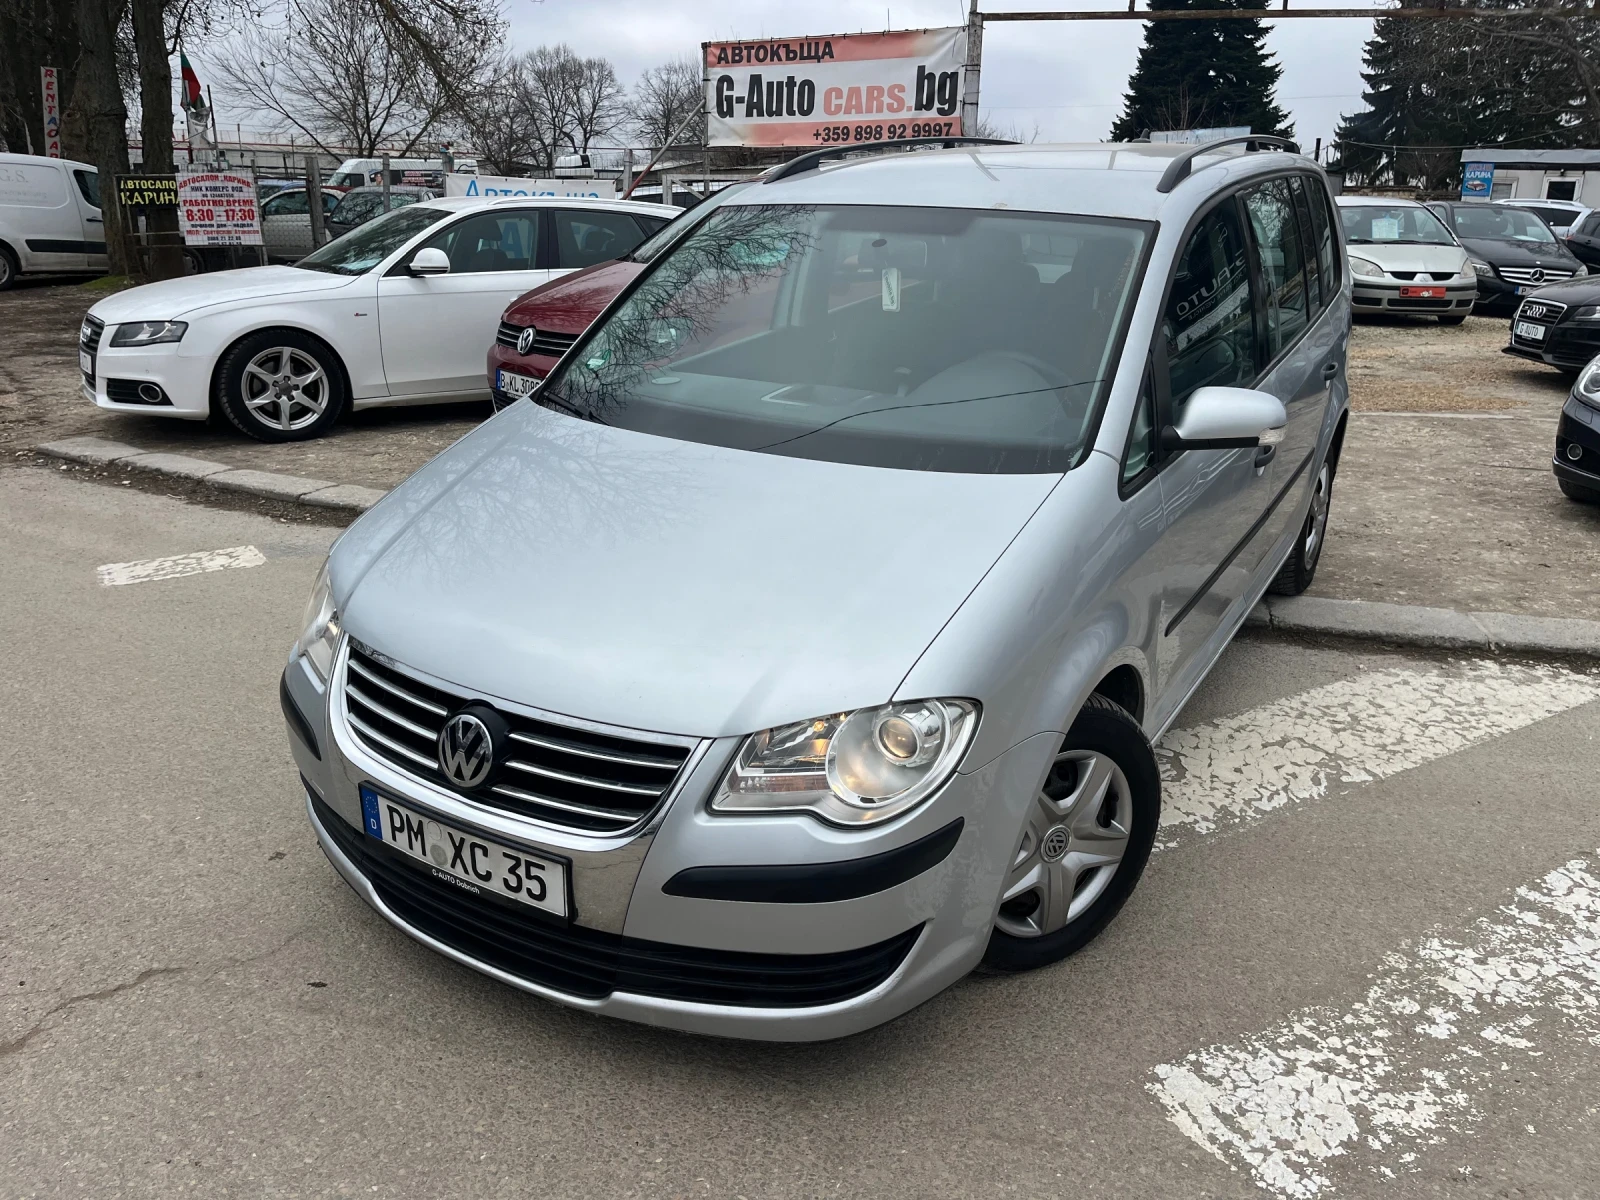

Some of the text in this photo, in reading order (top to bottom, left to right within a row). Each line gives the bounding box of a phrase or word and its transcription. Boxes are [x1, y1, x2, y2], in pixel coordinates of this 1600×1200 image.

[716, 41, 835, 64] АВТОКЪЩА
[44, 68, 57, 115] RENT
[716, 73, 816, 119] G-Auto
[813, 122, 953, 143] +359 898 92 9997
[120, 180, 177, 190] АВТОСАЛО
[178, 174, 219, 189] АВТОСАЛОН
[205, 185, 230, 193] КОМЕРС
[182, 199, 255, 207] РАБОТНО ВРЕМЕ
[186, 208, 214, 222] 8:30
[224, 208, 255, 221] 17:30
[1524, 325, 1539, 337] AUTO
[509, 375, 519, 393] KL
[370, 817, 377, 830] D
[386, 804, 547, 902] PM XC 35
[432, 868, 480, 895] G-AUTO Dobrich
